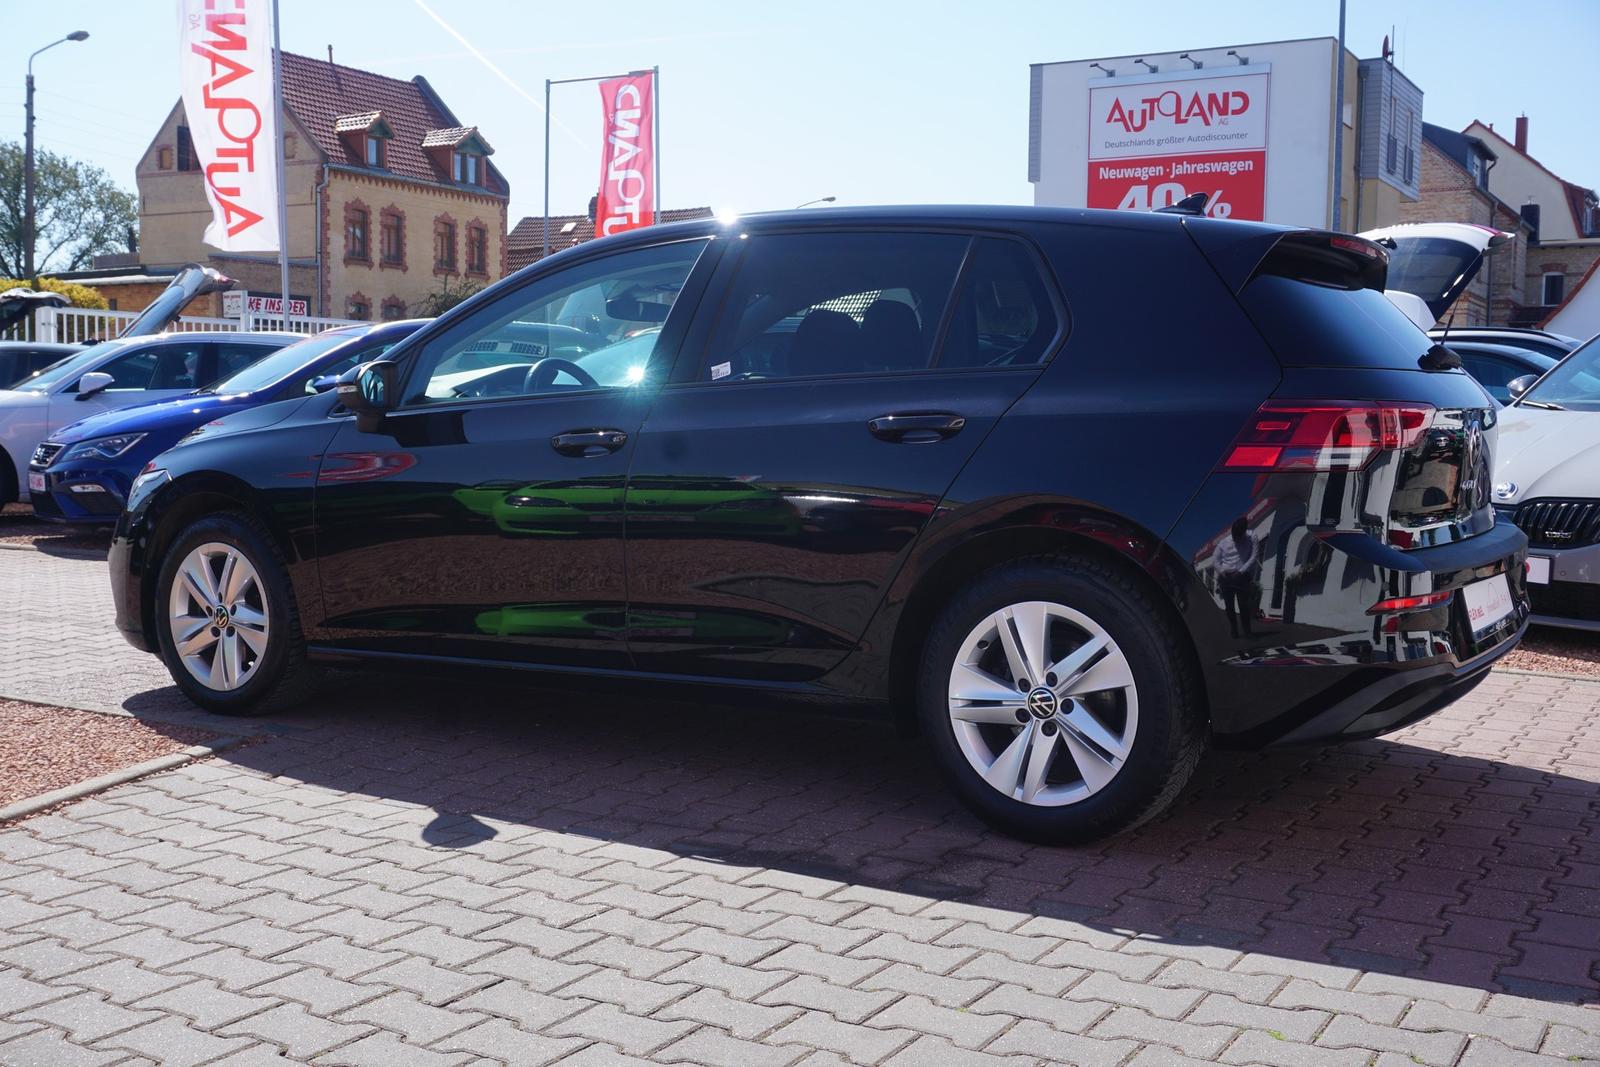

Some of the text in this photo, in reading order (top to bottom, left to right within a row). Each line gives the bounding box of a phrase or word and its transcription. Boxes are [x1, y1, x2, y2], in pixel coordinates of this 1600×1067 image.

[1106, 90, 1250, 133] AUTOLAND
[1218, 117, 1229, 126] AG
[1104, 132, 1249, 149] Deutschlands größter Autodiscounter
[1099, 159, 1254, 180] Neuwagen Jahreswagen
